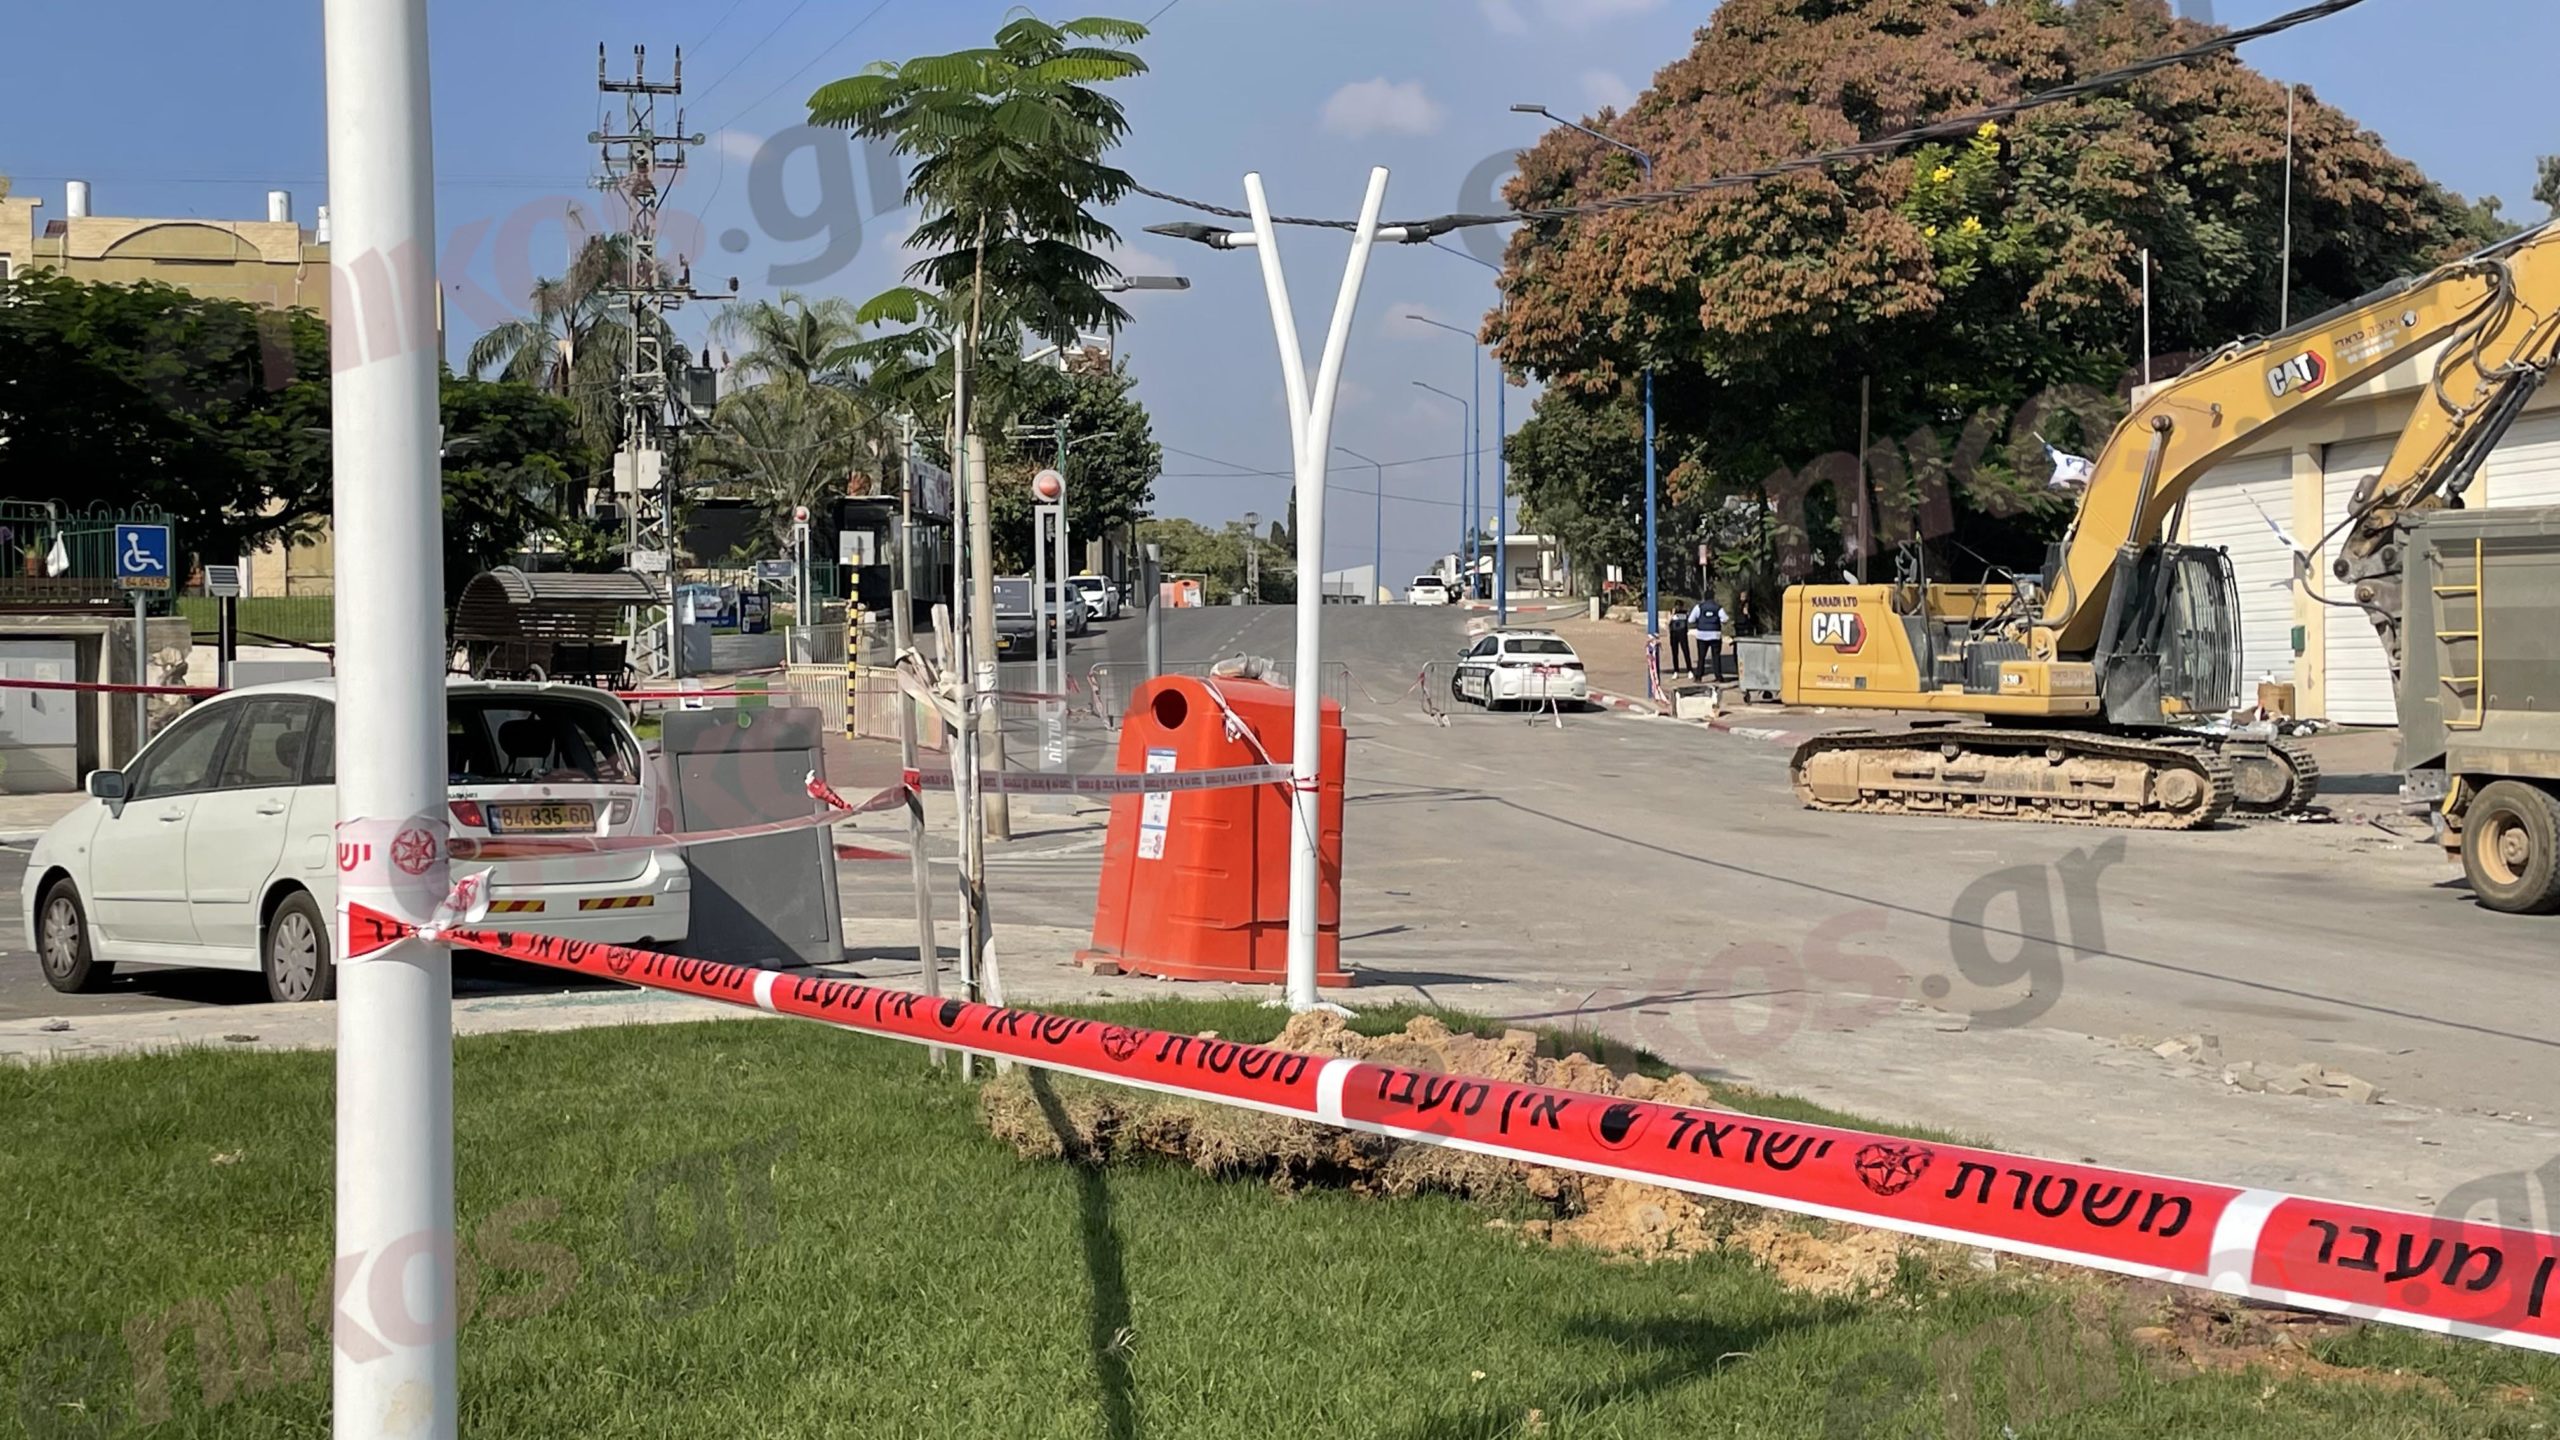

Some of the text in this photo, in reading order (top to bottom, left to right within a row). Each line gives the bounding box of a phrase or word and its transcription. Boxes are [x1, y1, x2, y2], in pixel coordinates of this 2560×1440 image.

[2266, 351, 2313, 397] CAT
[1811, 596, 1858, 607] KARADI LTD
[1811, 611, 1855, 646] CAT
[365, 917, 408, 942] בר
[527, 934, 599, 964] ישראל
[644, 953, 750, 990] משטרת
[794, 977, 1310, 1086] משטרת ישראל אין מעבר
[1376, 1067, 2193, 1238] משטרת ישראל אין מעבר
[2307, 1217, 2504, 1292] מעבר
